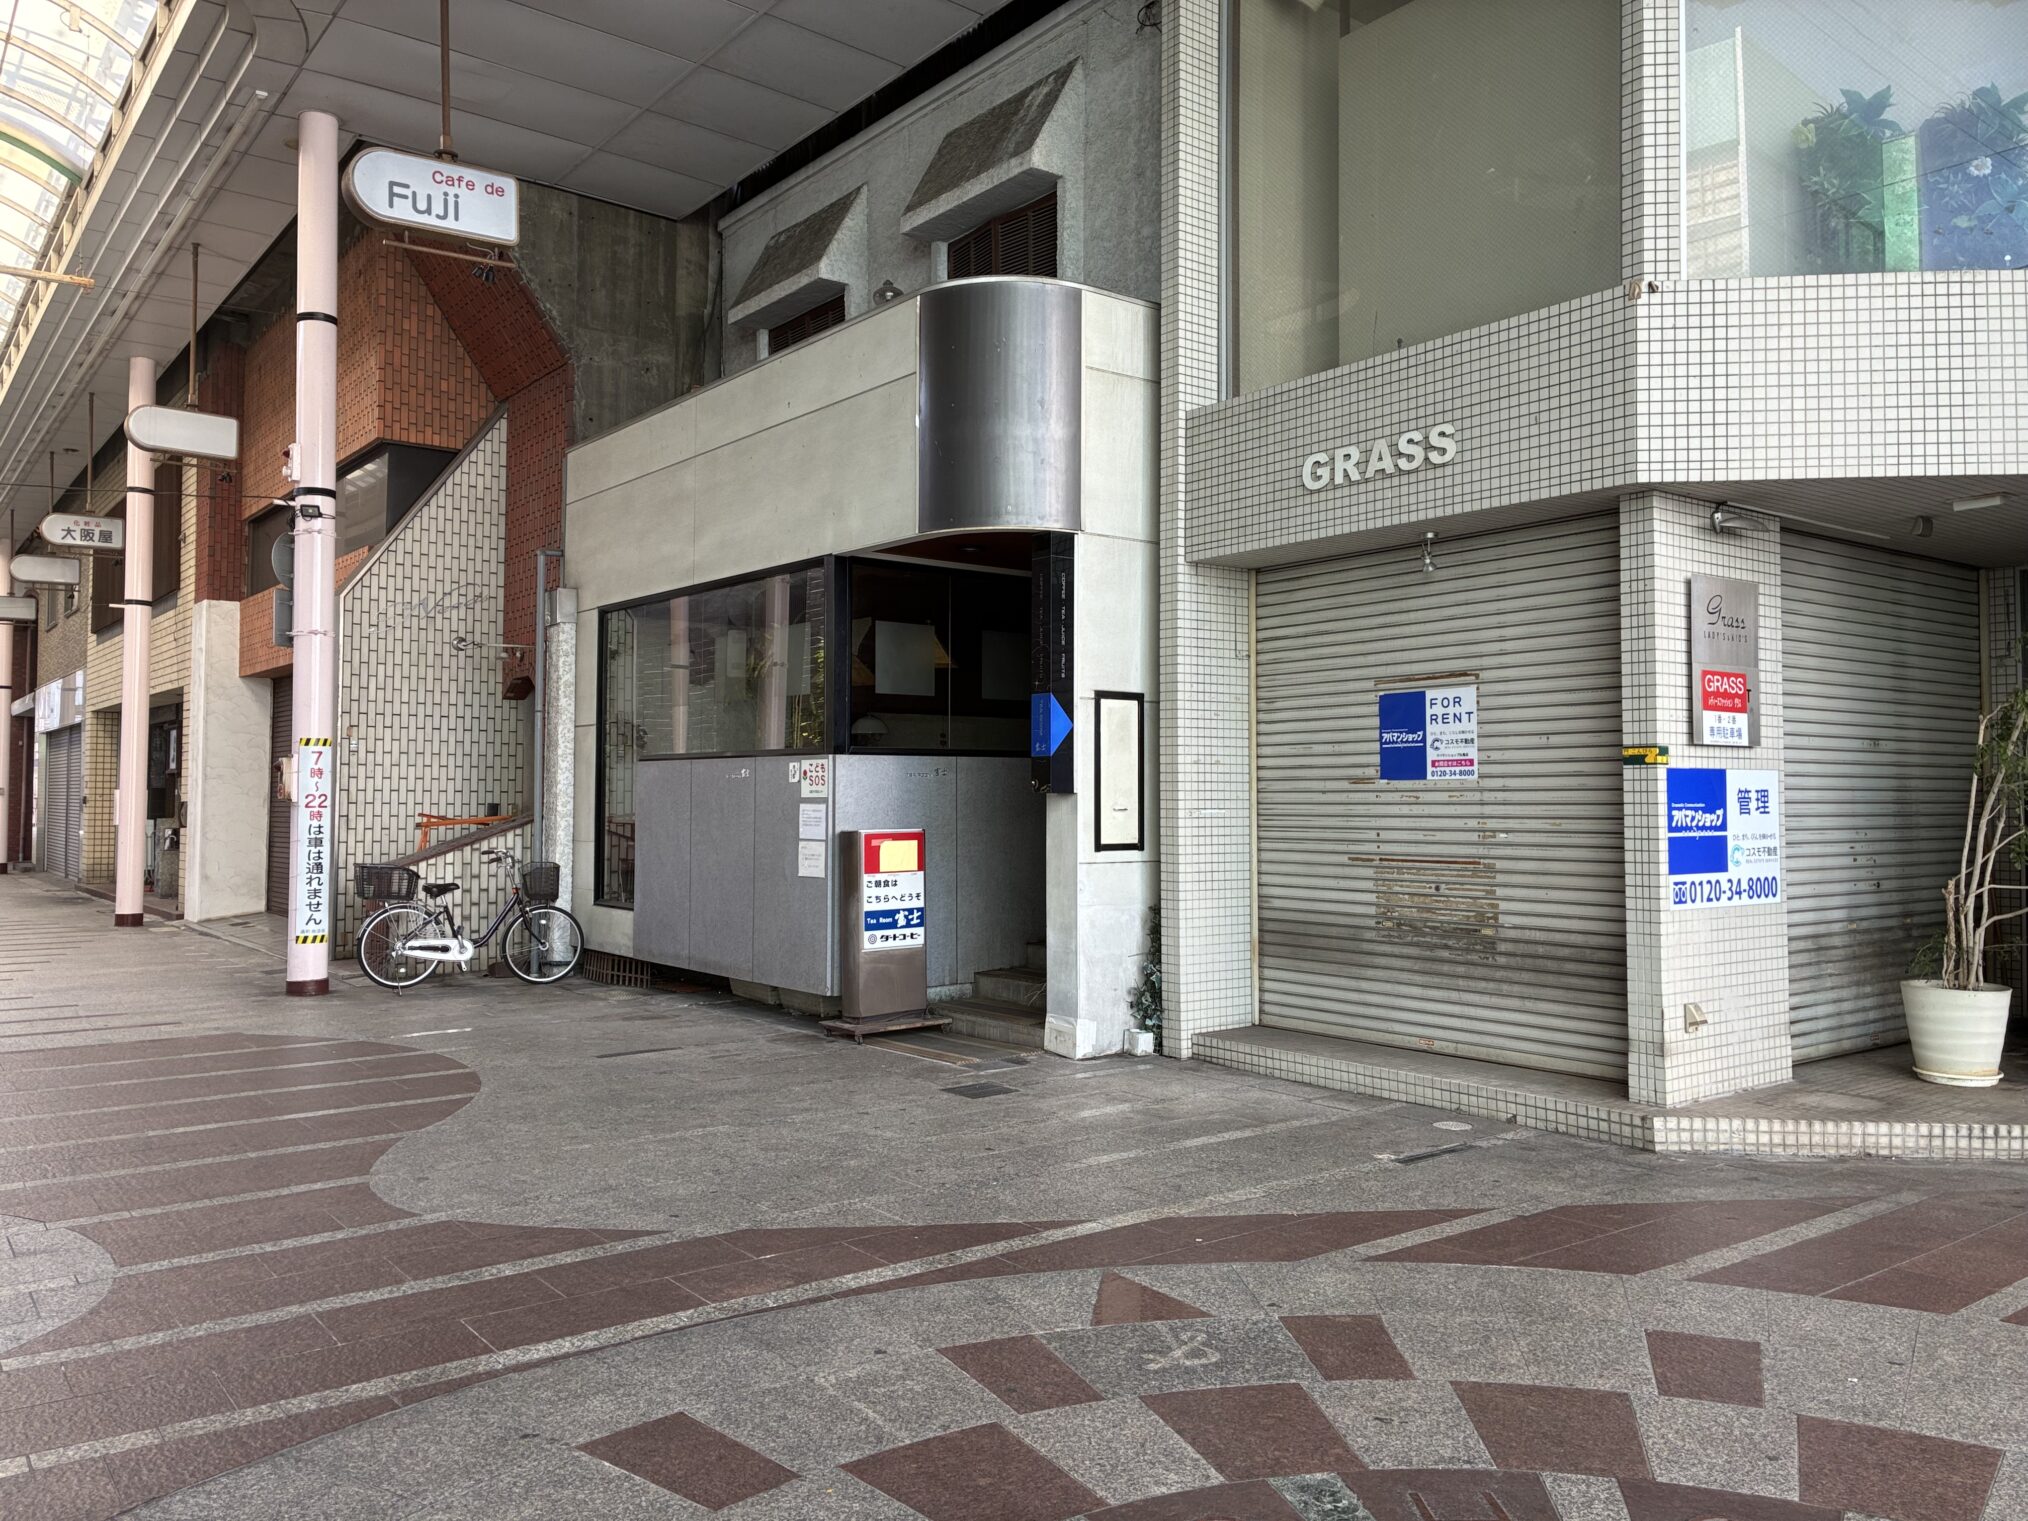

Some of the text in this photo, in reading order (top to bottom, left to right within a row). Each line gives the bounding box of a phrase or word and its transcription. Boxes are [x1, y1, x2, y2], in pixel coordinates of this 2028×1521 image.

[432, 170, 505, 197] Cafe de
[388, 180, 460, 222] Fuji
[1302, 422, 1457, 490] GRASS
[61, 526, 113, 544] 大阪屋
[1706, 594, 1747, 630] Grass
[1704, 674, 1744, 694] GRASS
[1430, 696, 1462, 709] FOR
[1430, 711, 1474, 725] RENT
[1382, 730, 1424, 743] アパマンショップ
[1709, 726, 1743, 740] 専用駐車場
[809, 763, 826, 773] こども
[1431, 769, 1475, 777] 0120-34-8000
[809, 775, 826, 787] SOS
[1737, 787, 1771, 816] 管理
[1671, 808, 1724, 827] アパマンショップ
[1745, 846, 1778, 857] コスモ不動産
[866, 879, 898, 889] ご朝食は
[1689, 876, 1778, 904] 0120-34-8000
[866, 892, 922, 904] こちらへどうぞ
[894, 909, 922, 928] 富士
